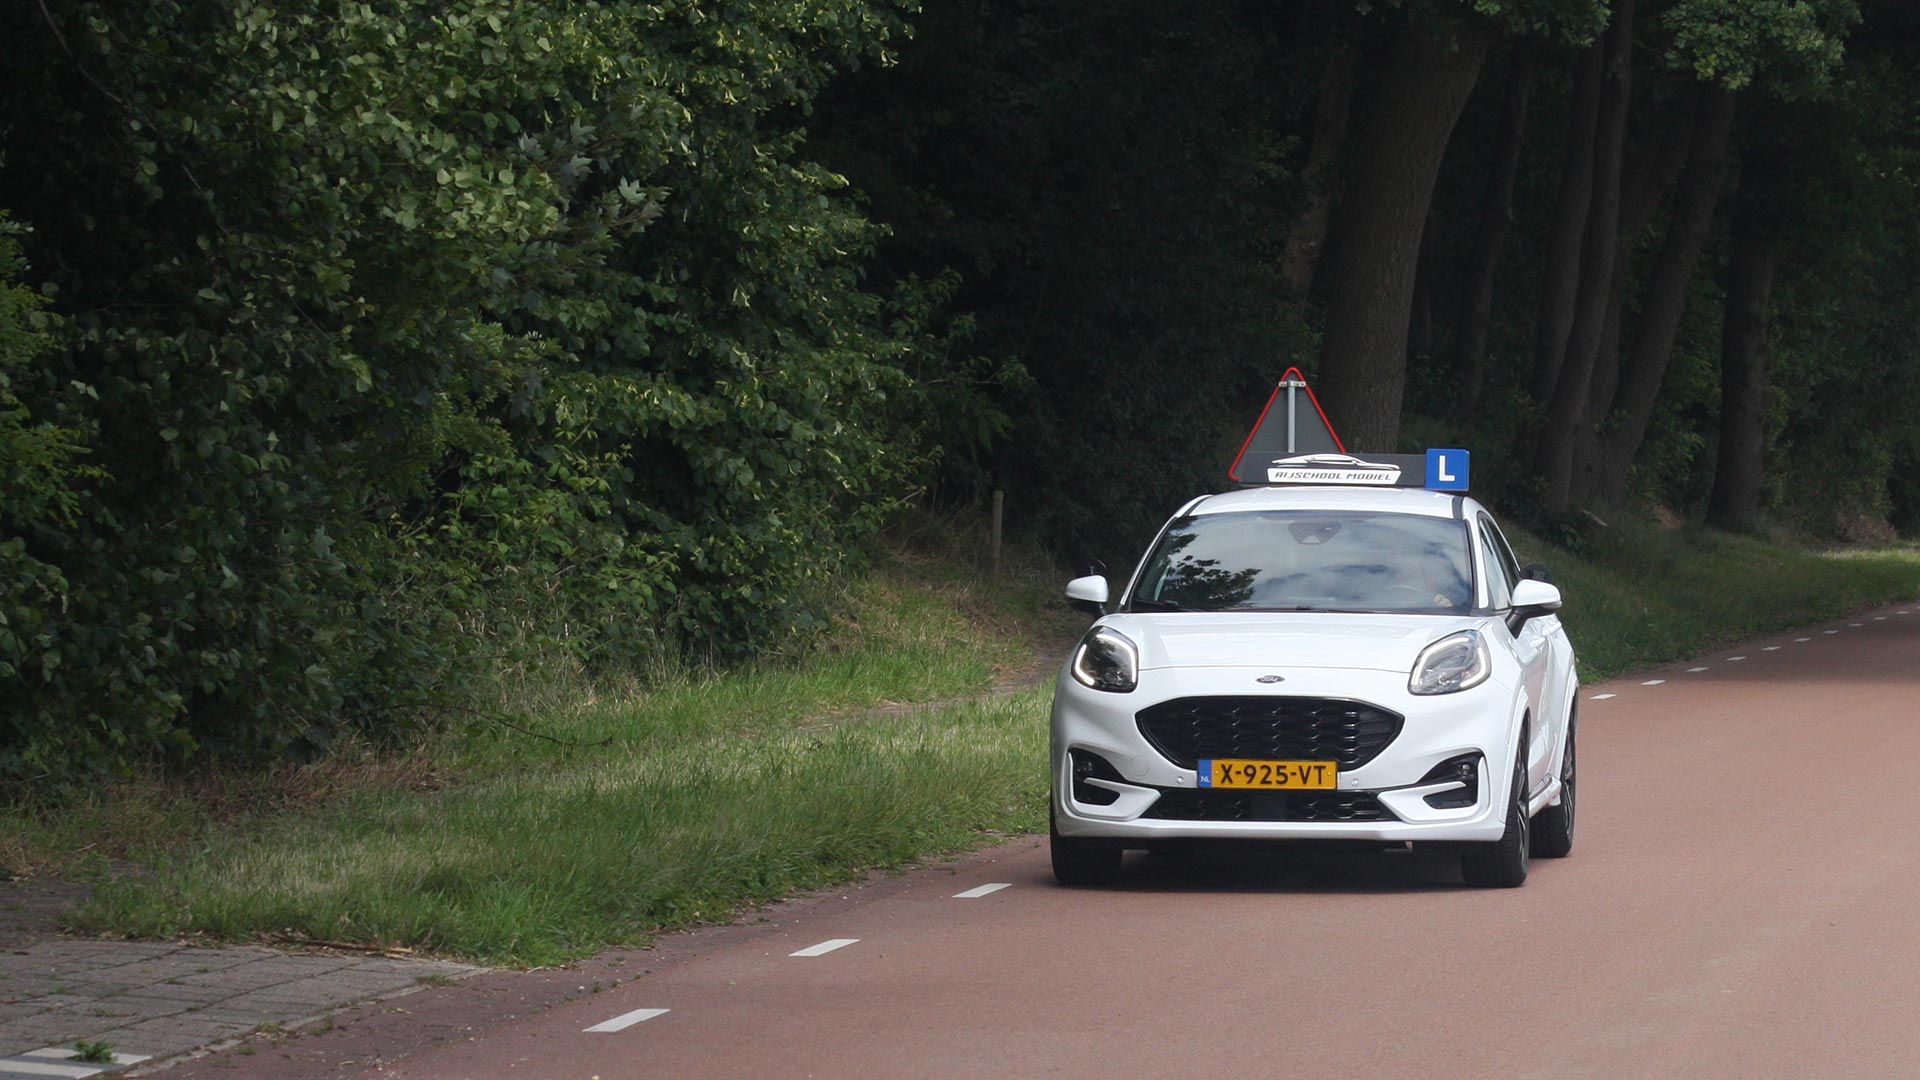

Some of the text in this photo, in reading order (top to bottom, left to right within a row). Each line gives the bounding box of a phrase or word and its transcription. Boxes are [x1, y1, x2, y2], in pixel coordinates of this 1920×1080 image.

[1274, 471, 1392, 481] RIJSCHOOL MOBIEL
[1439, 455, 1455, 481] L
[1220, 763, 1326, 785] X-925-VT
